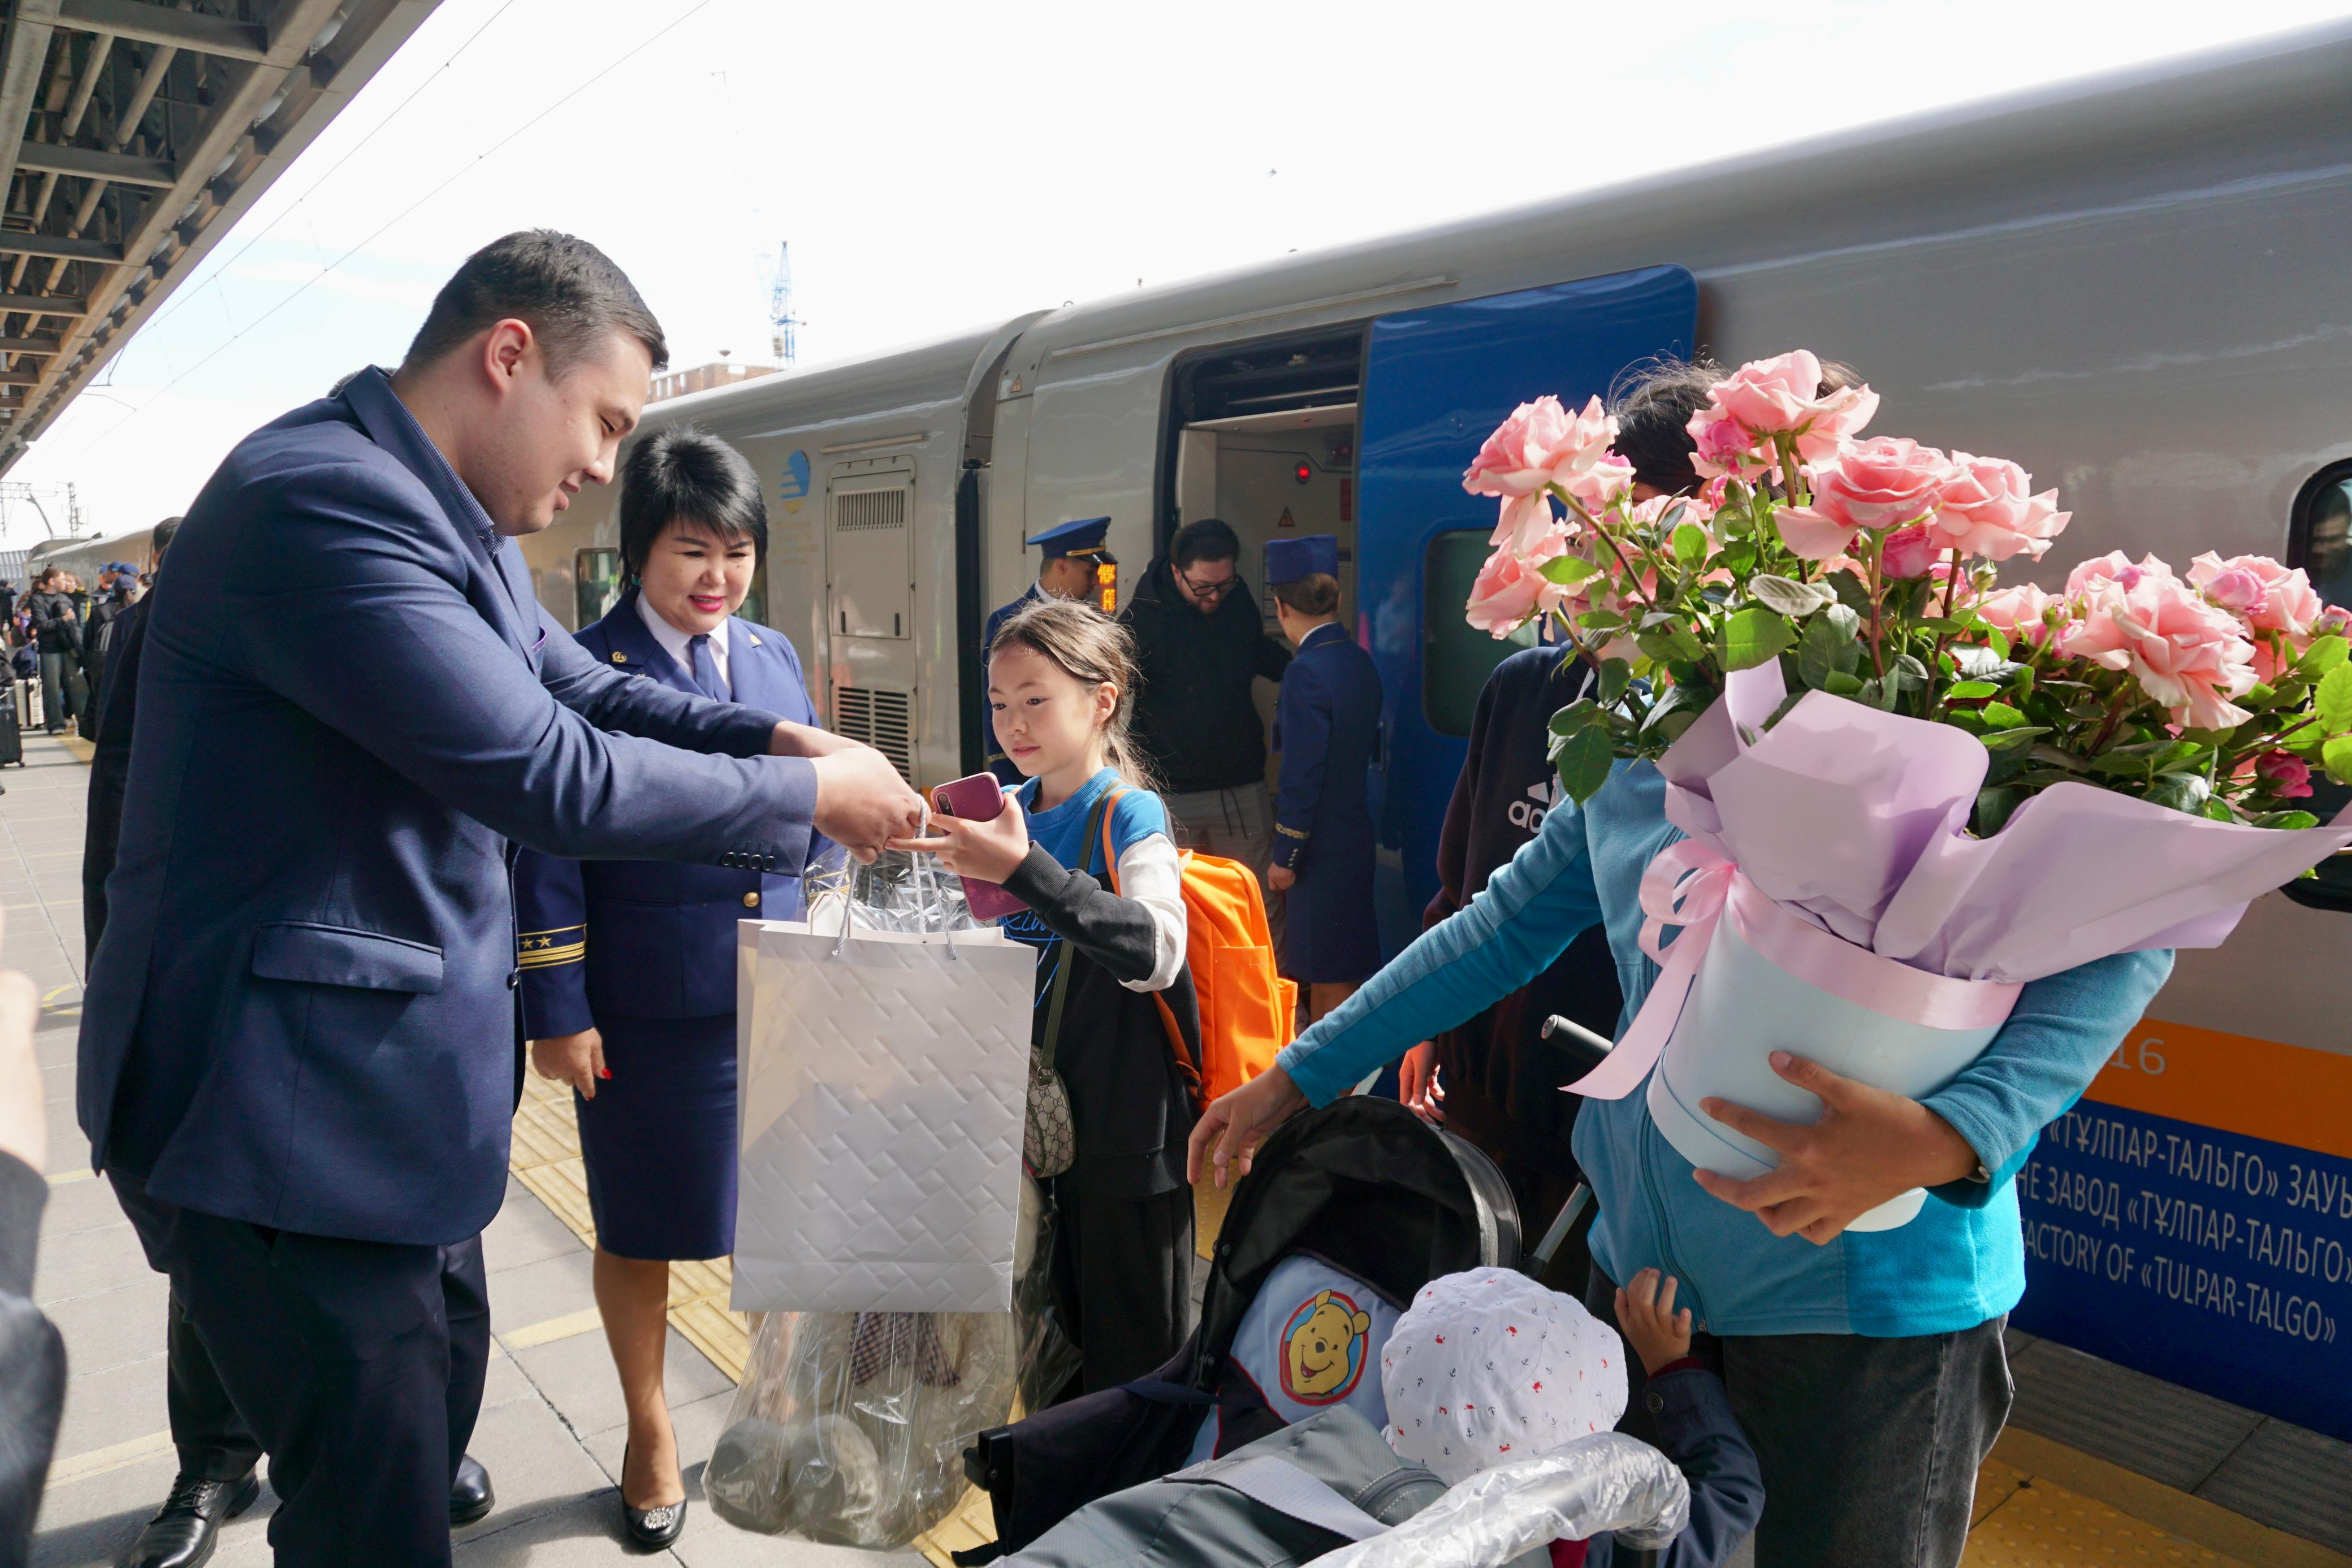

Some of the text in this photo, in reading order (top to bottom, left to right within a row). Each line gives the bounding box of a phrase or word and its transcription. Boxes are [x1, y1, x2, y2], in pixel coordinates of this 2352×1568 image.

[2046, 1166, 2120, 1231] ЗАВОД
[2021, 1218, 2337, 1344] ACTORY OF «TULPAR-TALGO»
